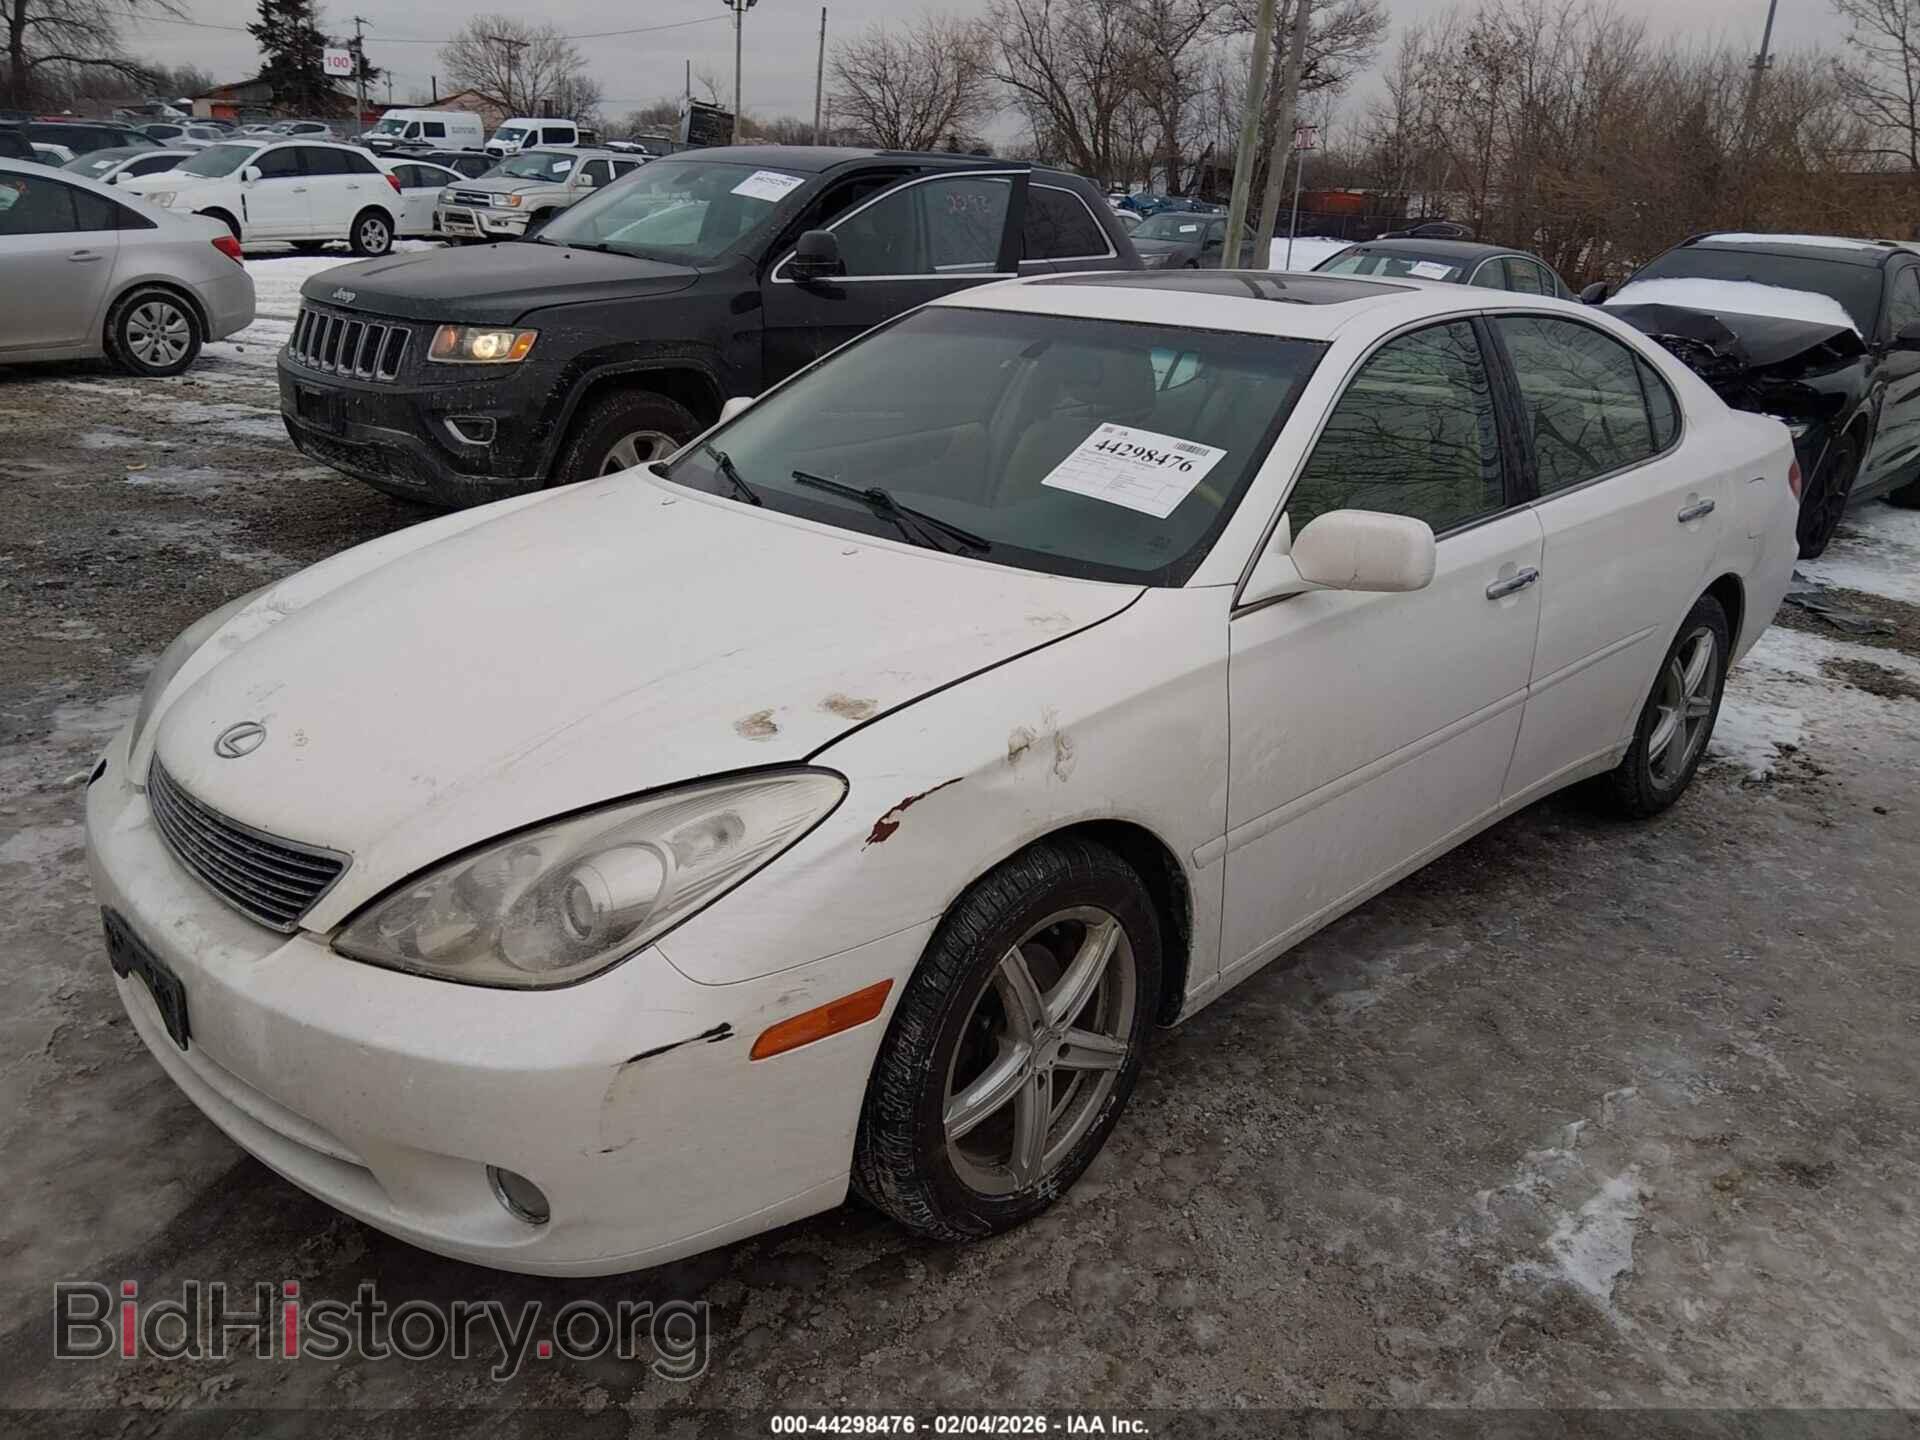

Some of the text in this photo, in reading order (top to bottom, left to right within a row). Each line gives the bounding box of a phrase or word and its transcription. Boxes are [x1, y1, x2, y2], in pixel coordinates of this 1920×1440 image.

[326, 56, 349, 68] 100
[332, 287, 356, 304] Jeep
[1095, 439, 1197, 472] 44298476
